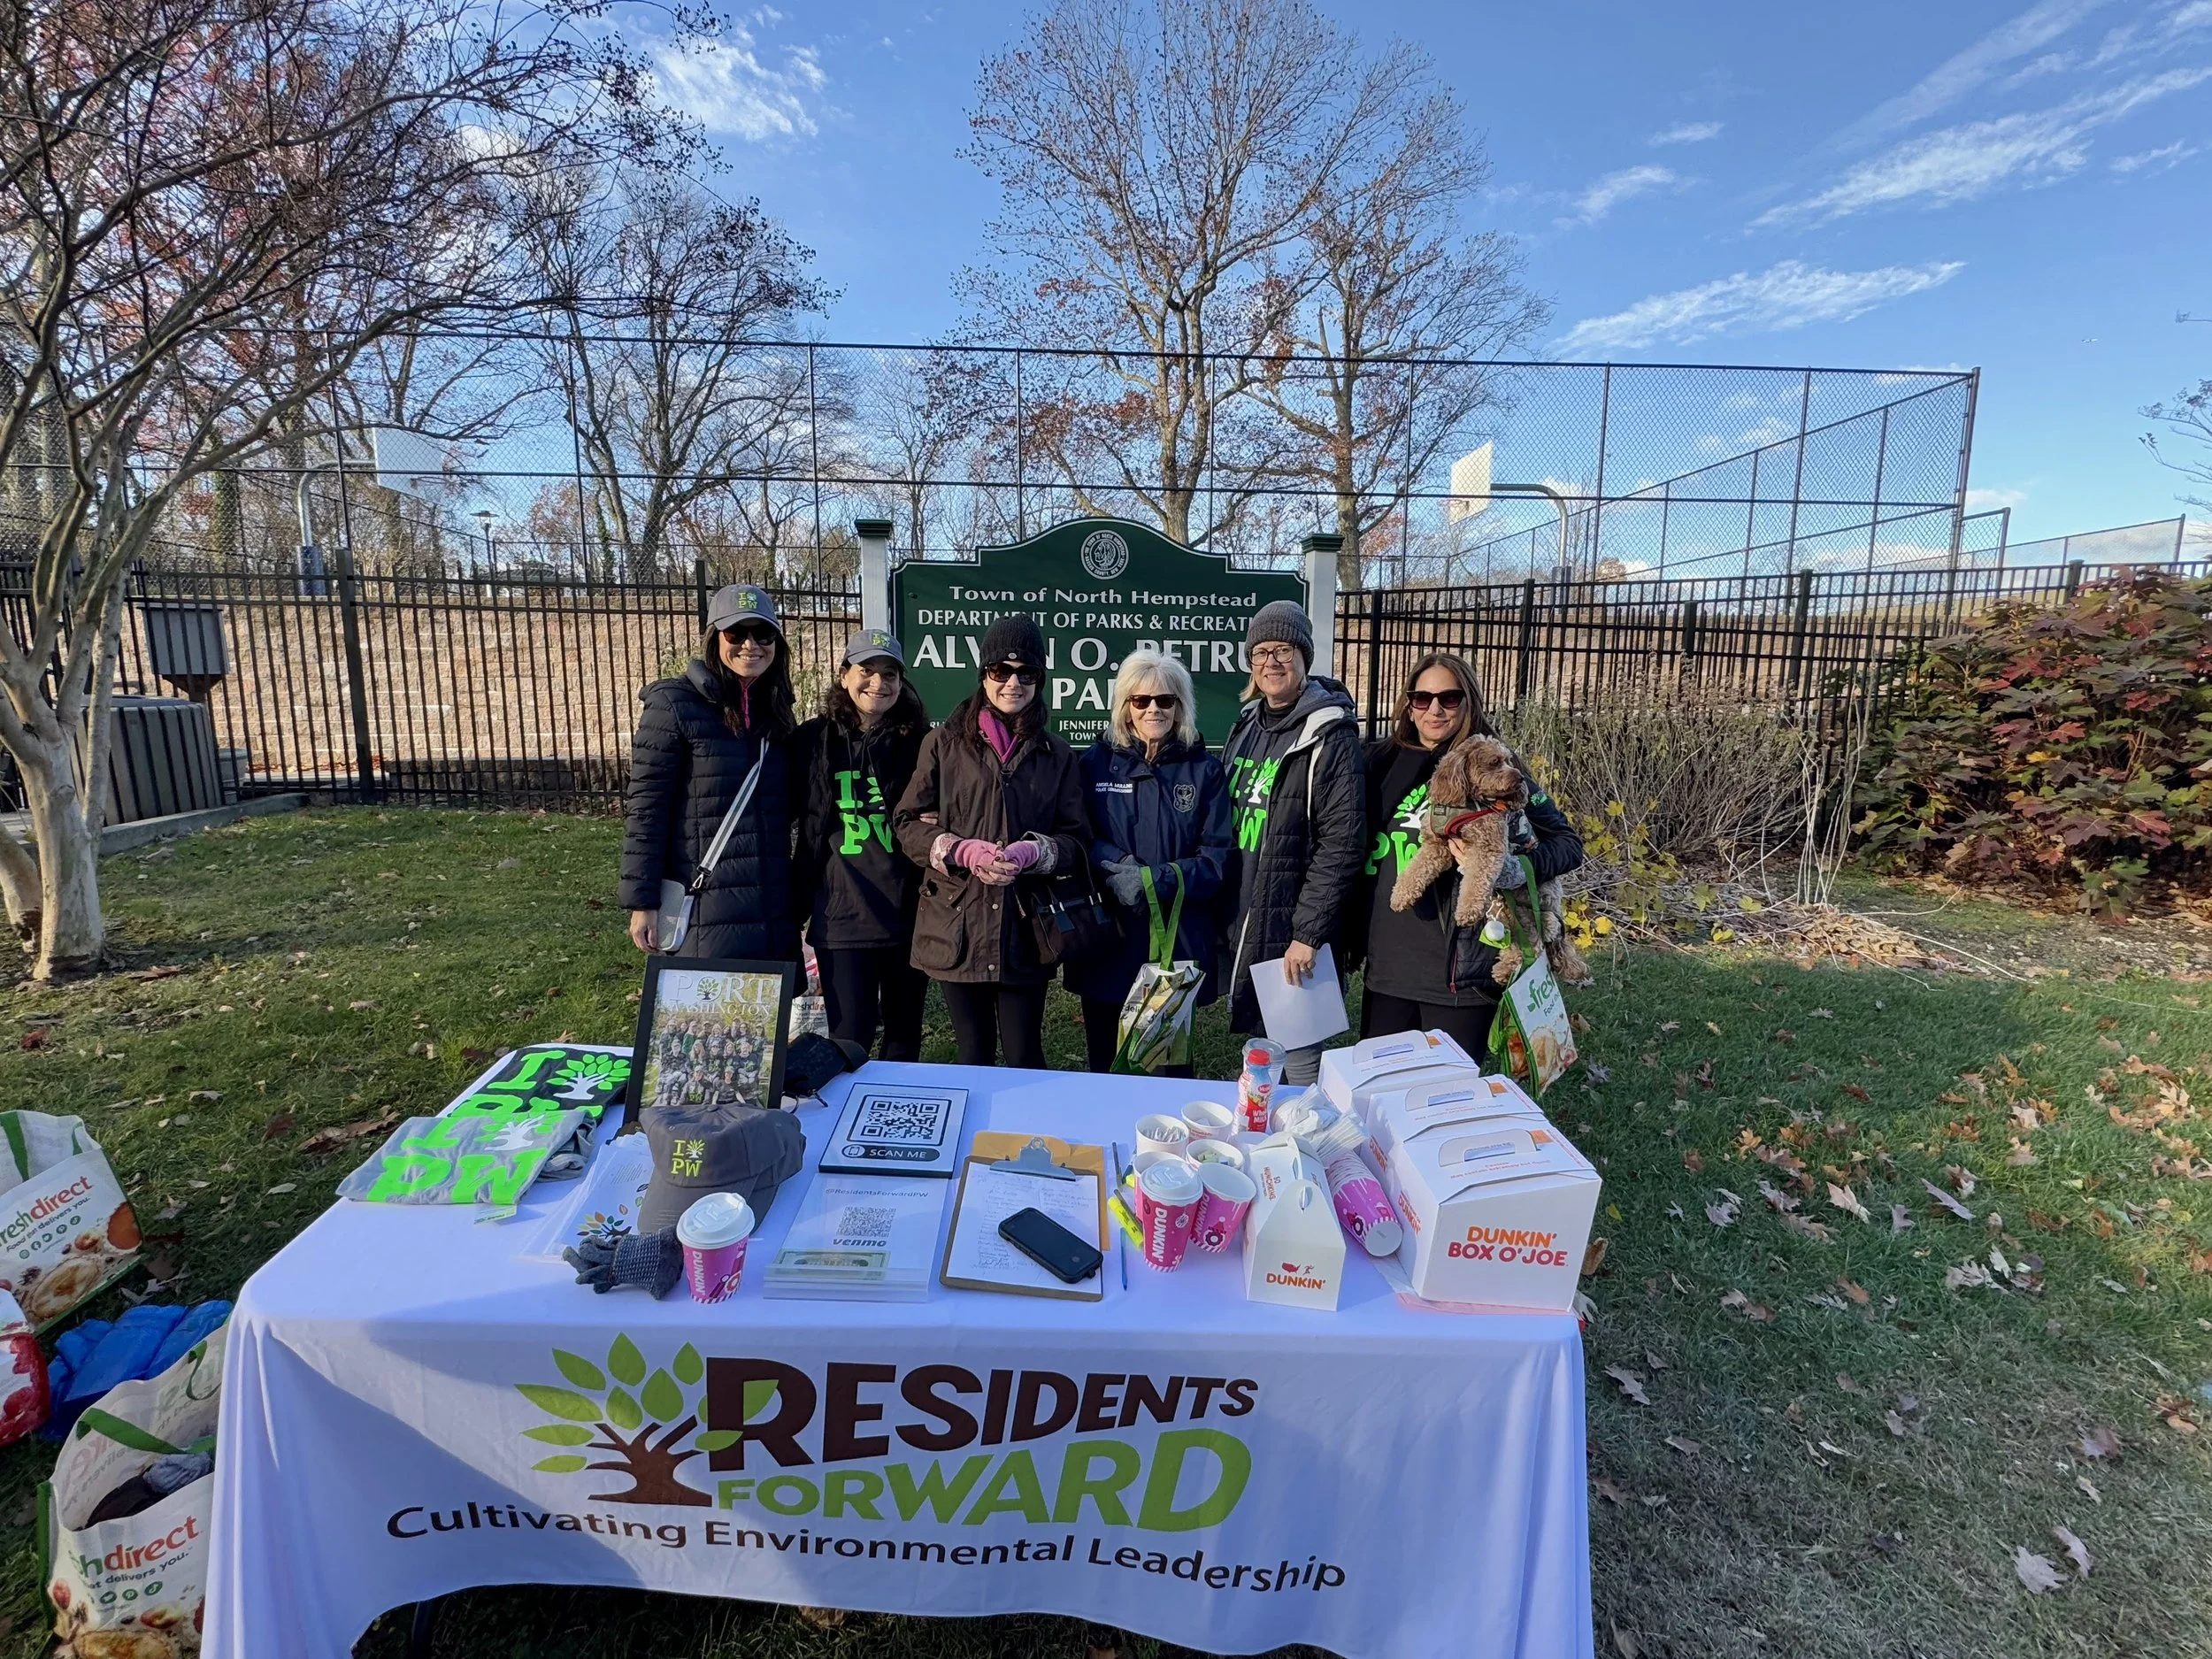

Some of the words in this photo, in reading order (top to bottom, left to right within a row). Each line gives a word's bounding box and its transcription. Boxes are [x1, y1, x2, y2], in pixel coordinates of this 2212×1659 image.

[738, 600, 758, 610] PW
[949, 586, 1015, 602] Town
[1023, 588, 1047, 603] of
[1055, 589, 1122, 603] North
[1131, 590, 1256, 610] Hempstead
[918, 610, 1048, 627] DEPARTT
[1053, 612, 1079, 628] OF
[1086, 613, 1144, 629] PARKS
[1148, 614, 1164, 630] &
[912, 634, 1055, 670] ALVN
[1071, 637, 1119, 671] O.
[1058, 719, 1110, 733] JENNIFER
[834, 771, 863, 810] I
[1233, 806, 1267, 852] W
[672, 974, 774, 1004] PORT
[669, 998, 770, 1018] WASHINGTON
[488, 1050, 566, 1090] I
[673, 1139, 687, 1156] I
[869, 1148, 902, 1158] SCAN
[907, 1149, 927, 1159] ME
[367, 1148, 550, 1205] PW
[671, 1157, 703, 1178] PW
[0, 1176, 93, 1248] reshdirect
[37, 1208, 73, 1230] delivers
[833, 1238, 887, 1248] venmo
[1152, 1207, 1168, 1263] DUNKIN'
[1467, 1225, 1557, 1248] DUNKIN'
[1448, 1241, 1495, 1261] BOX
[692, 1250, 705, 1296] DUNKIN'
[1266, 1272, 1326, 1290] DUNKIN'
[706, 1356, 1259, 1472] RESIDENTS
[717, 1428, 1252, 1532] FORWARD
[387, 1502, 687, 1548] Cultivating
[706, 1521, 1074, 1564] Environmental
[1088, 1538, 1346, 1593] Leadership
[105, 1566, 157, 1585] delivers
[159, 1551, 190, 1572] you.
